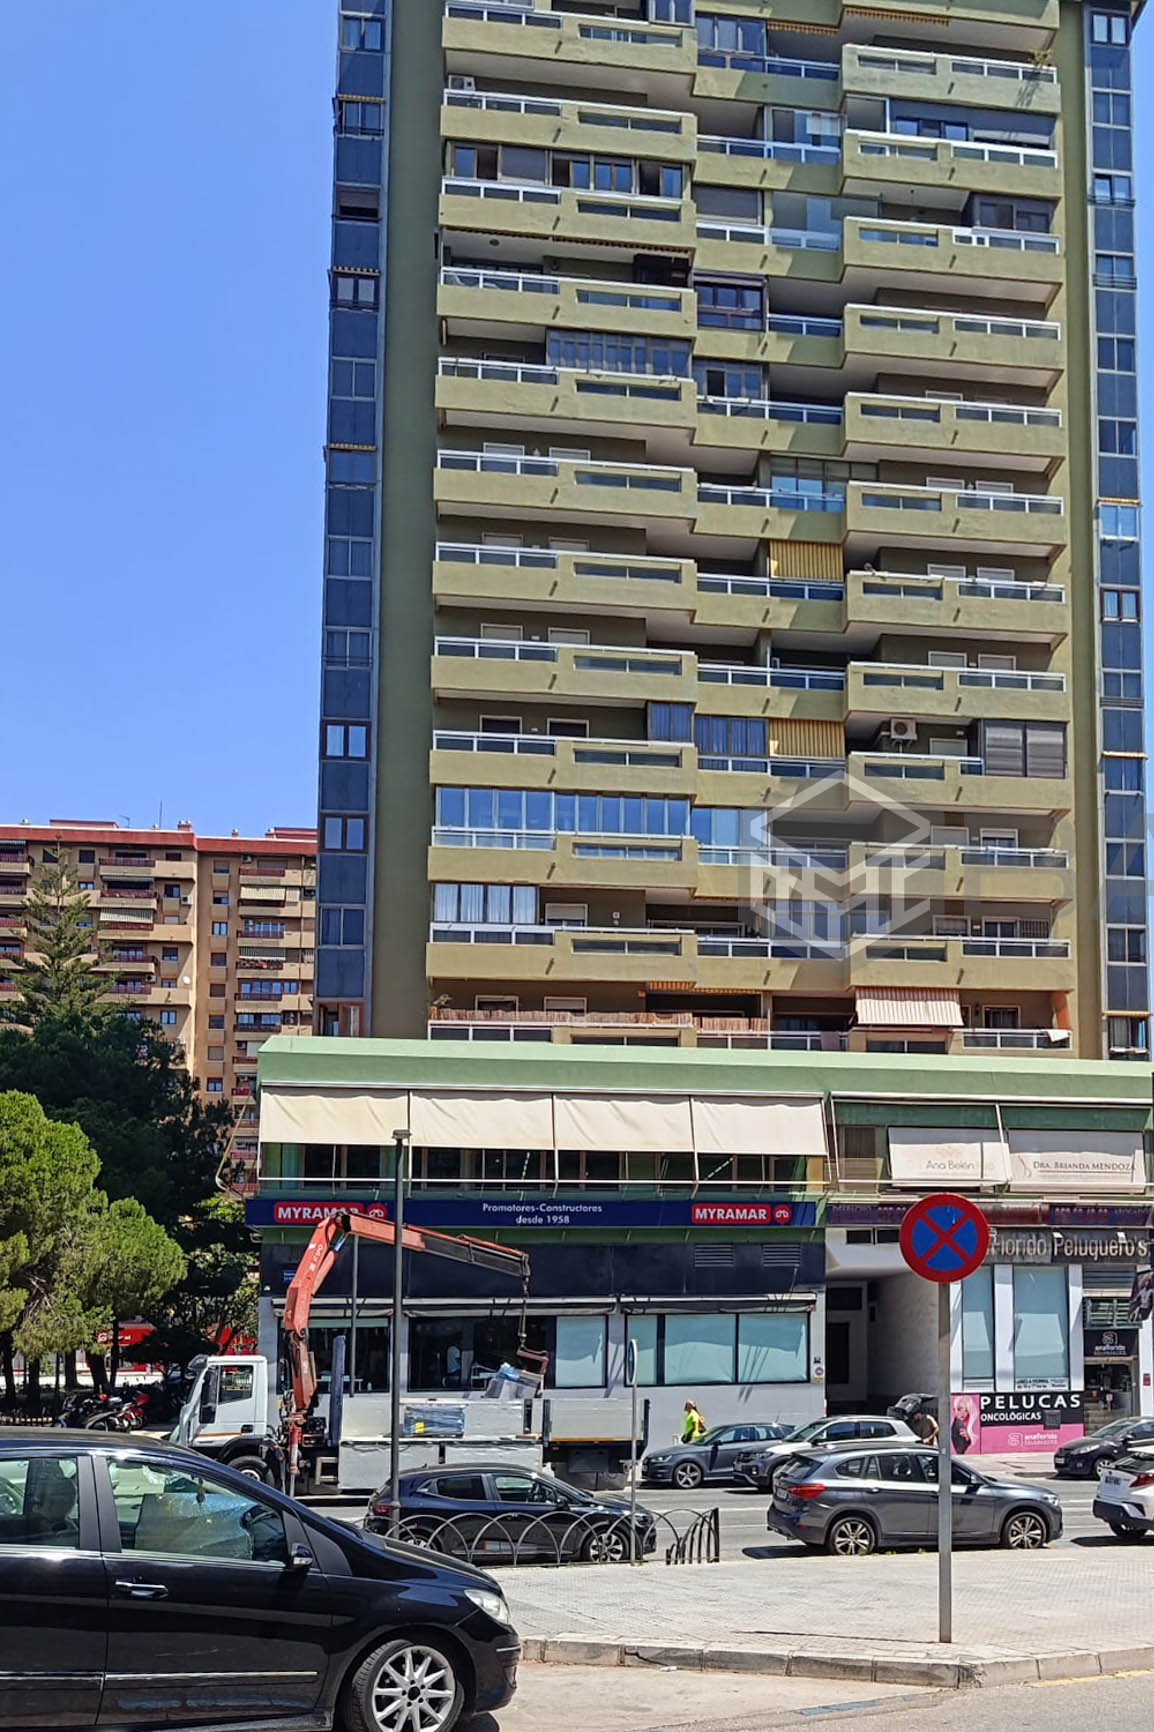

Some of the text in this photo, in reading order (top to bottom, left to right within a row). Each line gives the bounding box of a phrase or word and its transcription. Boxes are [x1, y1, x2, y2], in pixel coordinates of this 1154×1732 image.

[515, 1215, 570, 1224] desde 1958
[695, 1208, 767, 1220] MYRAMAR
[980, 1394, 1080, 1410] PELUCAS
[980, 1411, 1042, 1422] ONCOLÓGICAS
